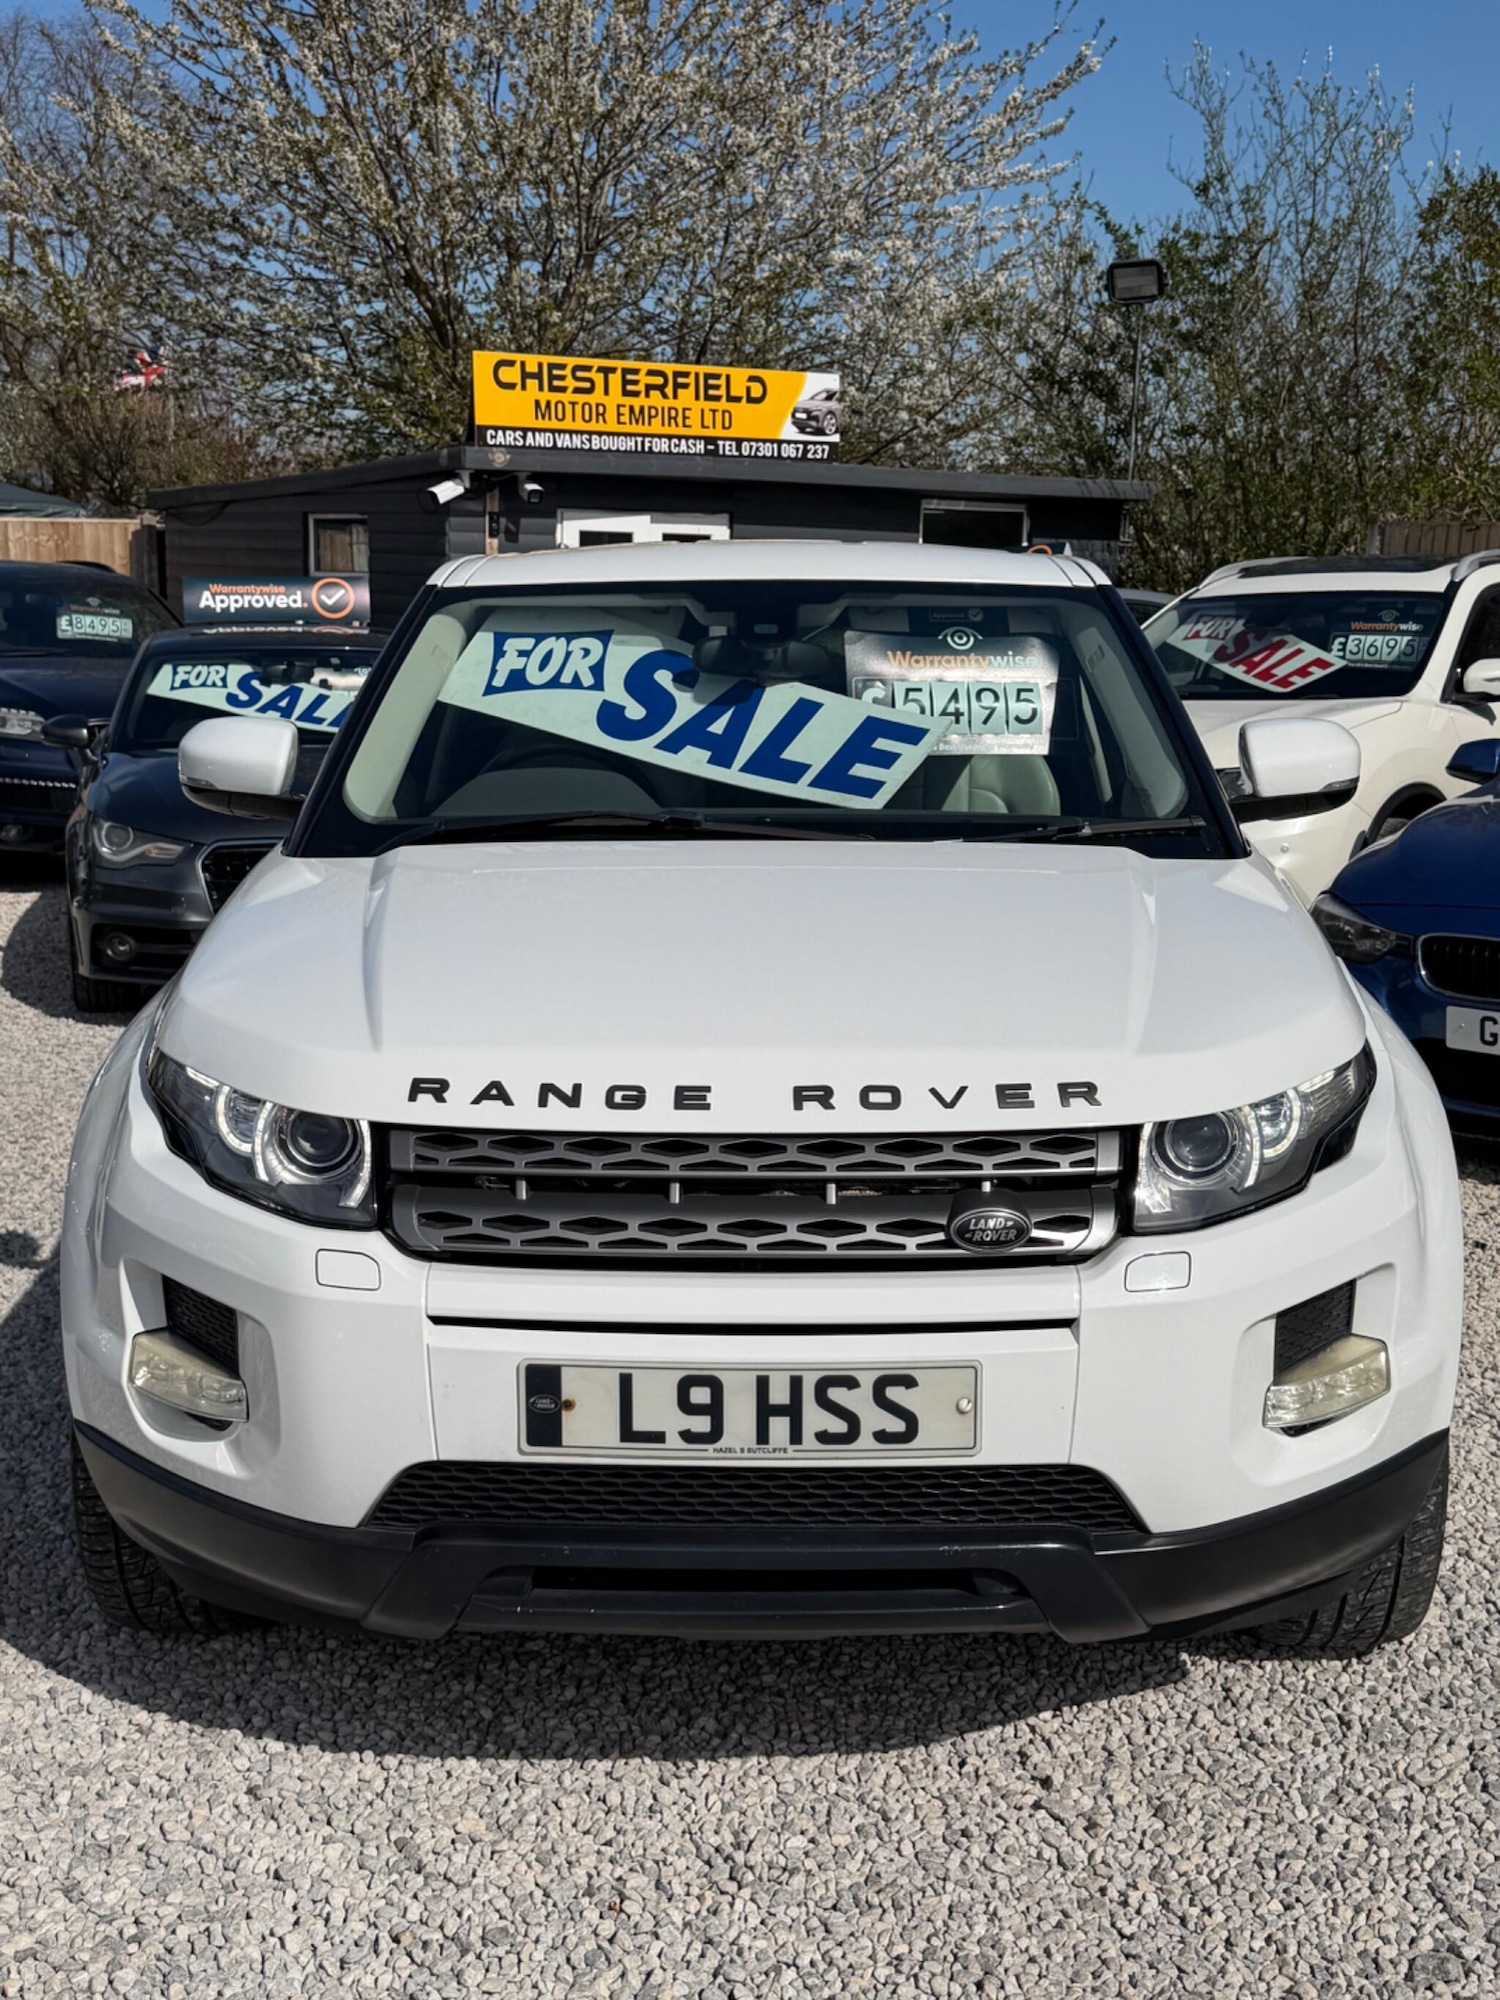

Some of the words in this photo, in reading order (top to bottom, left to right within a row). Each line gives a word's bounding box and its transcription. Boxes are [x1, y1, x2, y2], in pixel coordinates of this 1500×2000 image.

[492, 358, 768, 405] CHESTERFIELD
[534, 399, 607, 425] MOTOR
[616, 404, 692, 429] EMPIRE
[700, 409, 732, 430] LTD
[486, 429, 524, 446] CARS
[525, 432, 553, 448] AND
[555, 433, 590, 450] VANS
[591, 435, 643, 452] BOUGHT
[644, 437, 669, 453] FOR
[670, 439, 705, 455] CASH
[717, 441, 739, 456] TEL
[741, 442, 778, 458] 07301
[780, 444, 804, 459] 067
[806, 445, 829, 460] 237
[208, 583, 286, 594] Warrantywise
[60, 615, 120, 634] £8495
[1187, 616, 1236, 639] FOR
[1351, 621, 1424, 632] Warrantywise
[1331, 636, 1417, 658] £3695
[492, 636, 604, 689] FOR
[886, 650, 1039, 672] Warrantywise
[1213, 629, 1335, 689] SALE
[173, 665, 227, 687] FOR
[597, 649, 931, 799] SALE
[408, 1076, 712, 1110] RANGE
[793, 1081, 1103, 1110] ROVER
[969, 1217, 1006, 1230] LAND
[972, 1229, 1017, 1242] ROVER
[619, 1373, 724, 1445] L9
[756, 1374, 920, 1445] HSS
